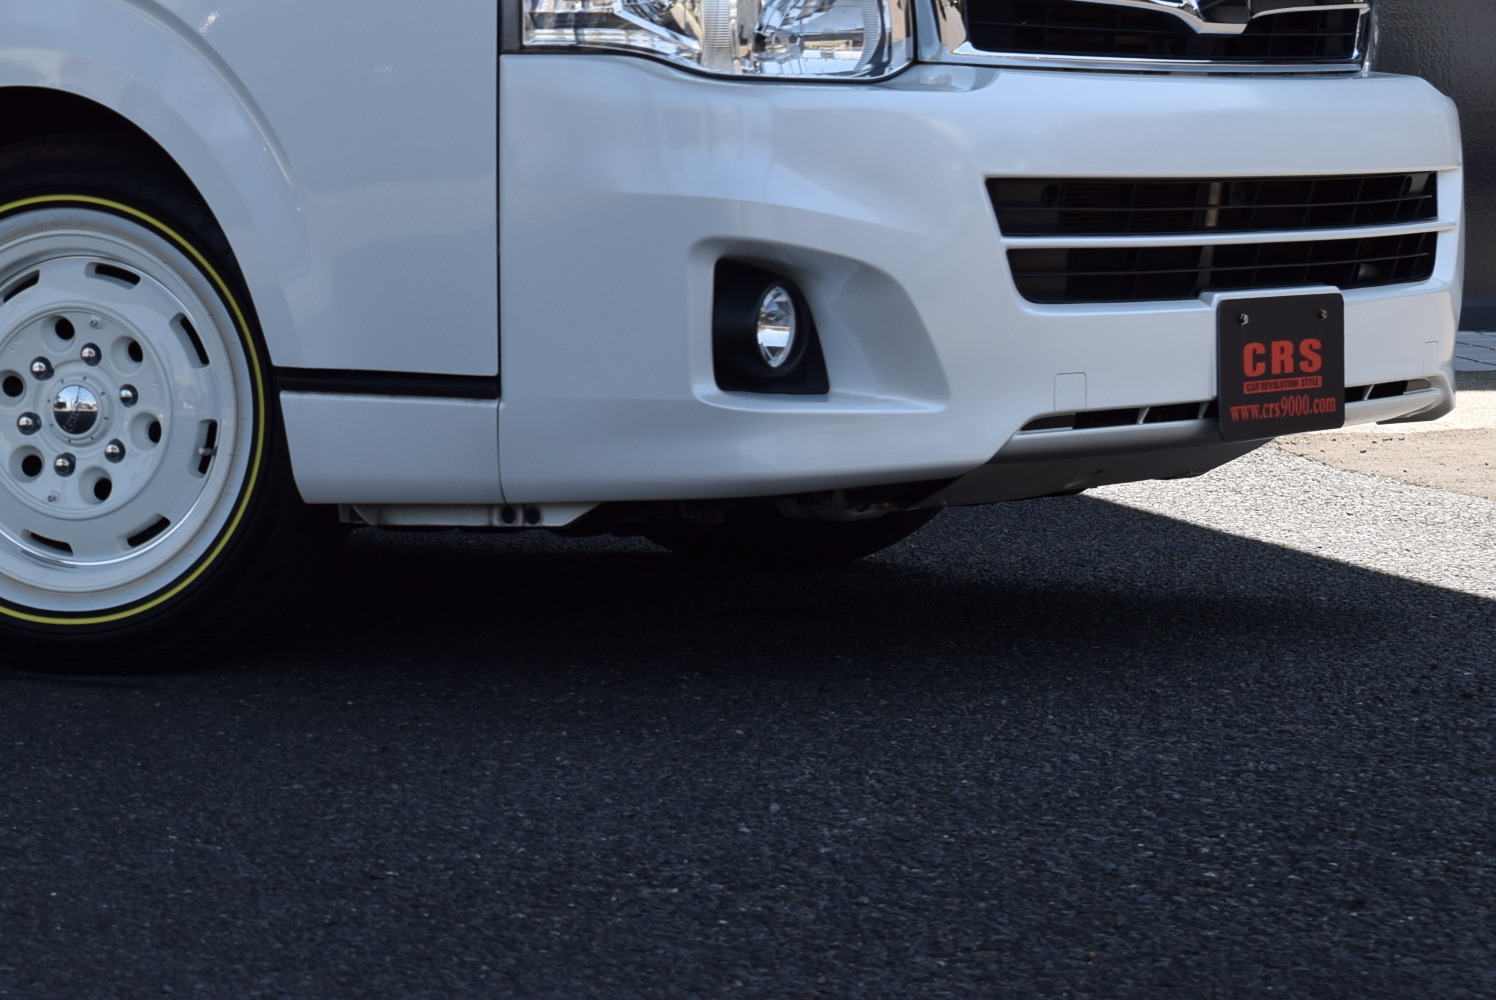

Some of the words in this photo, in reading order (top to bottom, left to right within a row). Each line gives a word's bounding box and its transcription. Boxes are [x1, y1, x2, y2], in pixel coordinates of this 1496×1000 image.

[1243, 338, 1322, 377] CRS
[1246, 382, 1260, 392] CAR
[1260, 380, 1299, 391] REVOLUTION
[1301, 377, 1319, 387] STYLE
[1230, 394, 1336, 421] www.crs9000.com
